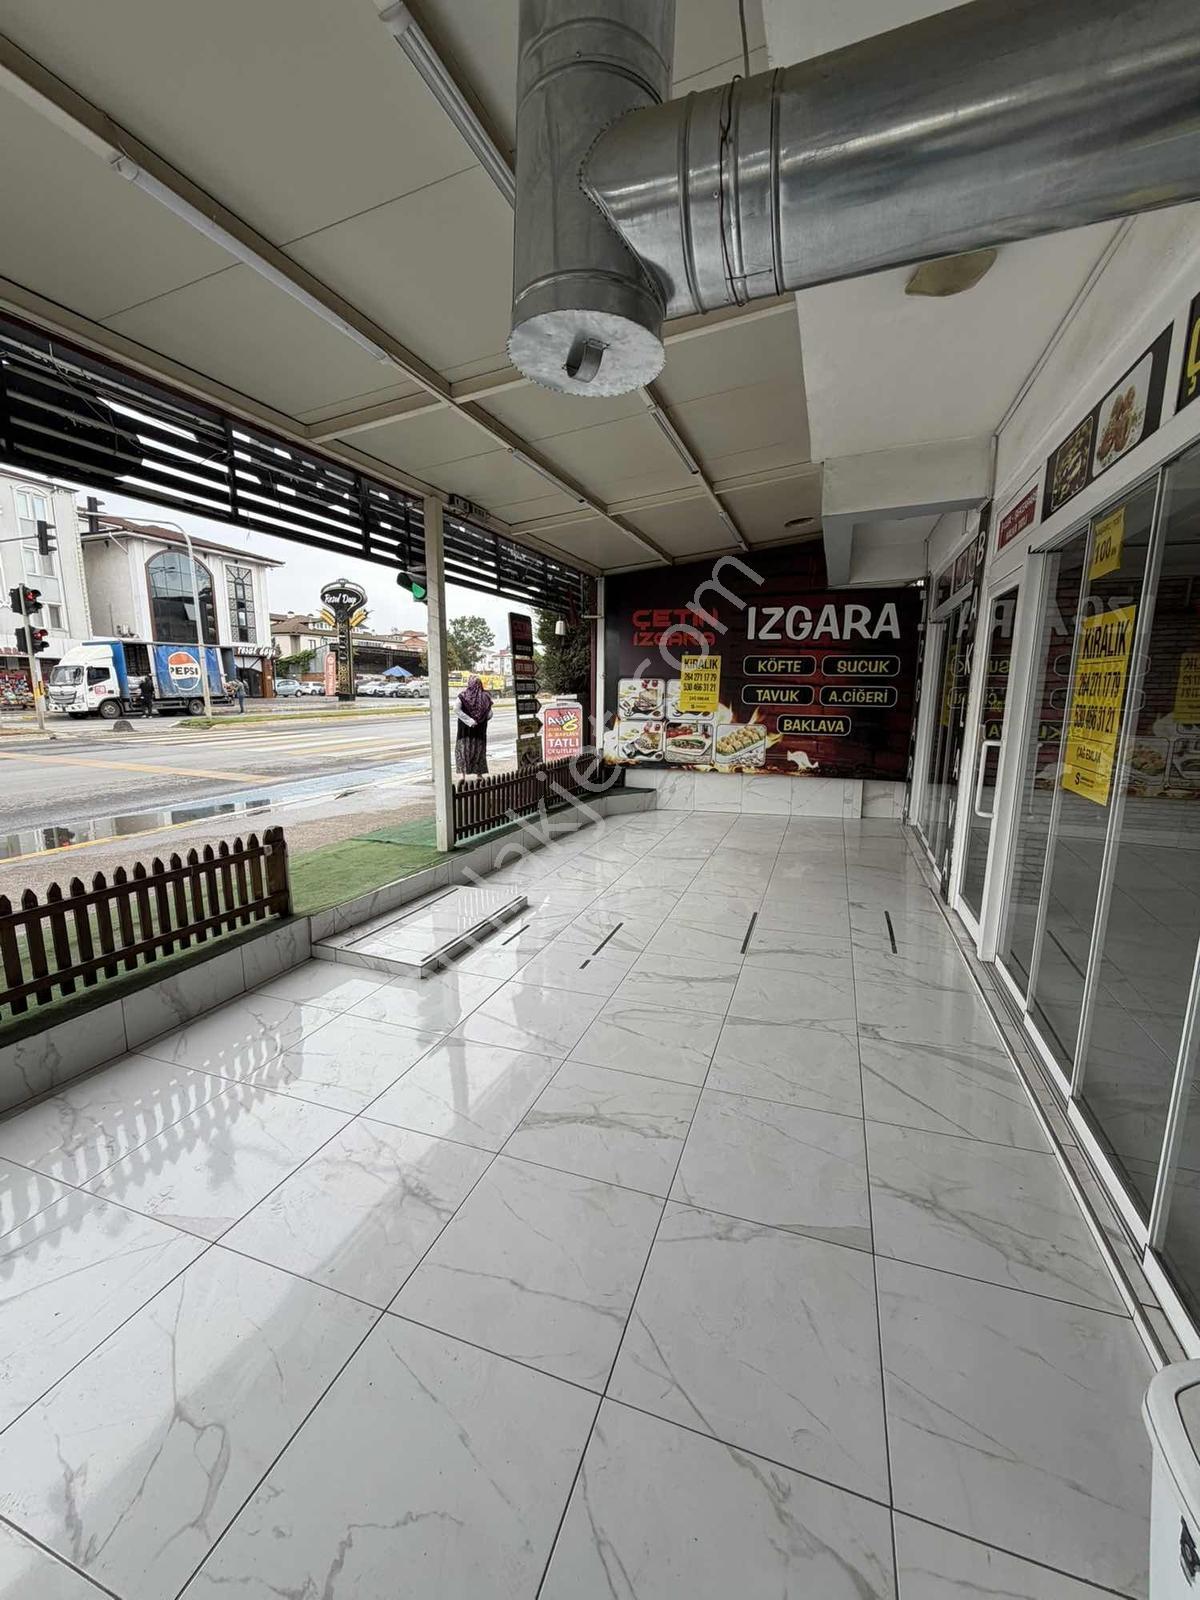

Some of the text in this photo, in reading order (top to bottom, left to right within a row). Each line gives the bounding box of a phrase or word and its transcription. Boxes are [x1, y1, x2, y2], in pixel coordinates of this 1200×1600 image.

[747, 602, 901, 641] IZGARA
[1081, 619, 1131, 660] KİRALIK
[170, 666, 199, 676] PEPSI
[758, 657, 803, 673] KÖFTE
[836, 660, 890, 674] SUCUK
[756, 689, 800, 702] TAVUK
[783, 719, 845, 733] BAKLAVA
[548, 738, 579, 747] TATLI
